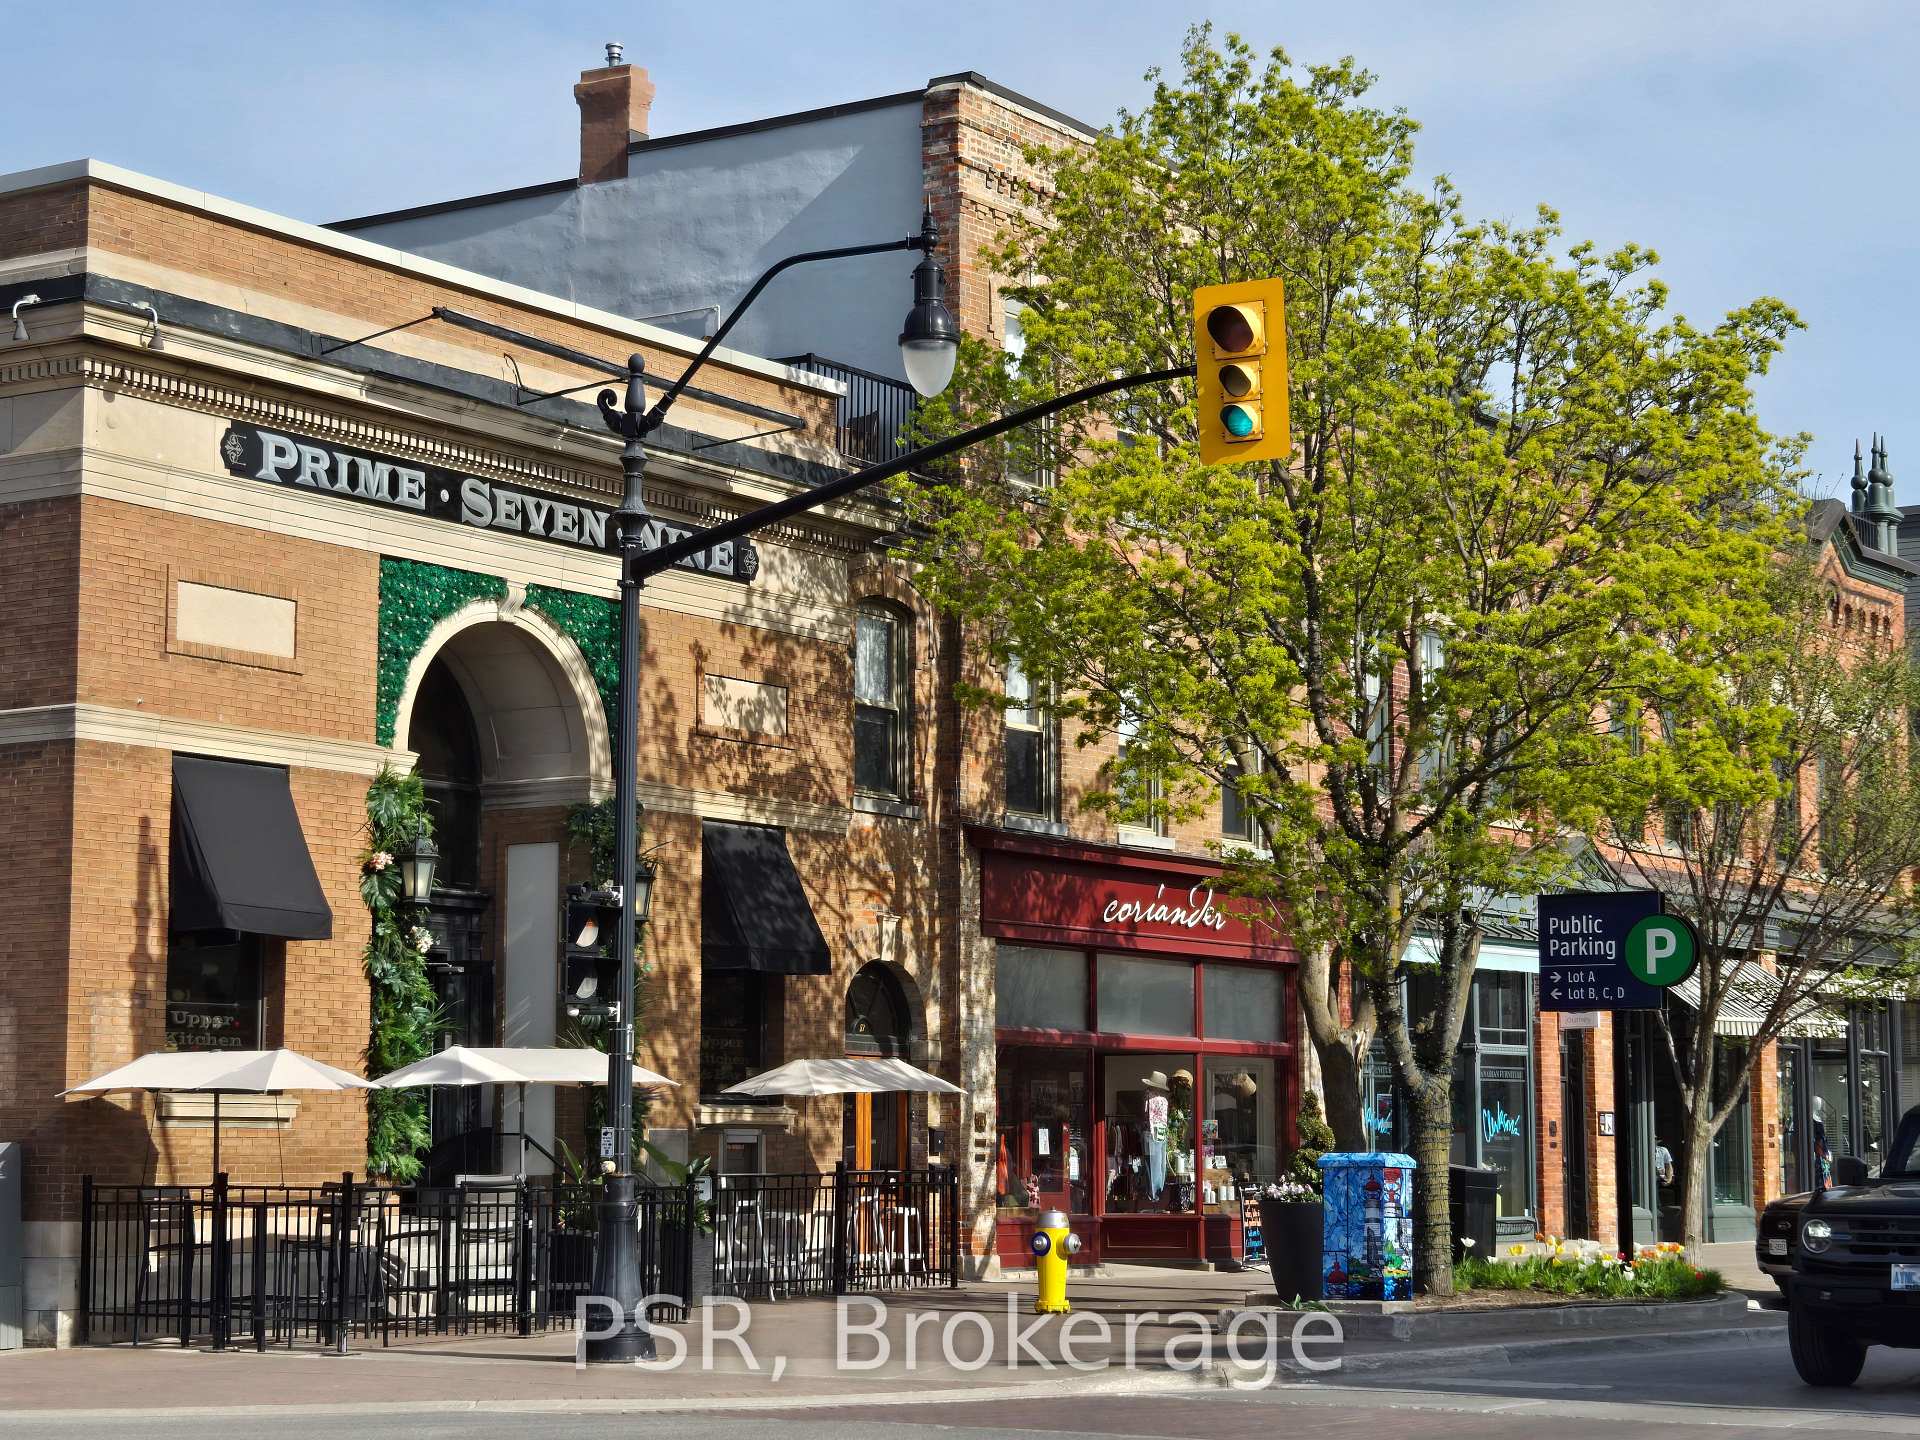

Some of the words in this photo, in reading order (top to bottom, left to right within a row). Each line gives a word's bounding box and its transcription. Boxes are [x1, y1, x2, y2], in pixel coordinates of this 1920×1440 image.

[255, 431, 426, 511] PRIME
[460, 478, 610, 548] SEVEN
[1103, 883, 1226, 930] coriander
[1549, 914, 1603, 935] Public
[1549, 936, 1616, 960] Parking
[1646, 928, 1677, 975] P
[1568, 971, 1585, 983] Lot
[1588, 971, 1596, 982] A
[1568, 987, 1585, 1000] Lot
[1588, 987, 1599, 1000] B,
[1603, 987, 1613, 1000] C,
[1617, 987, 1625, 999] D
[169, 1011, 234, 1029] Upper
